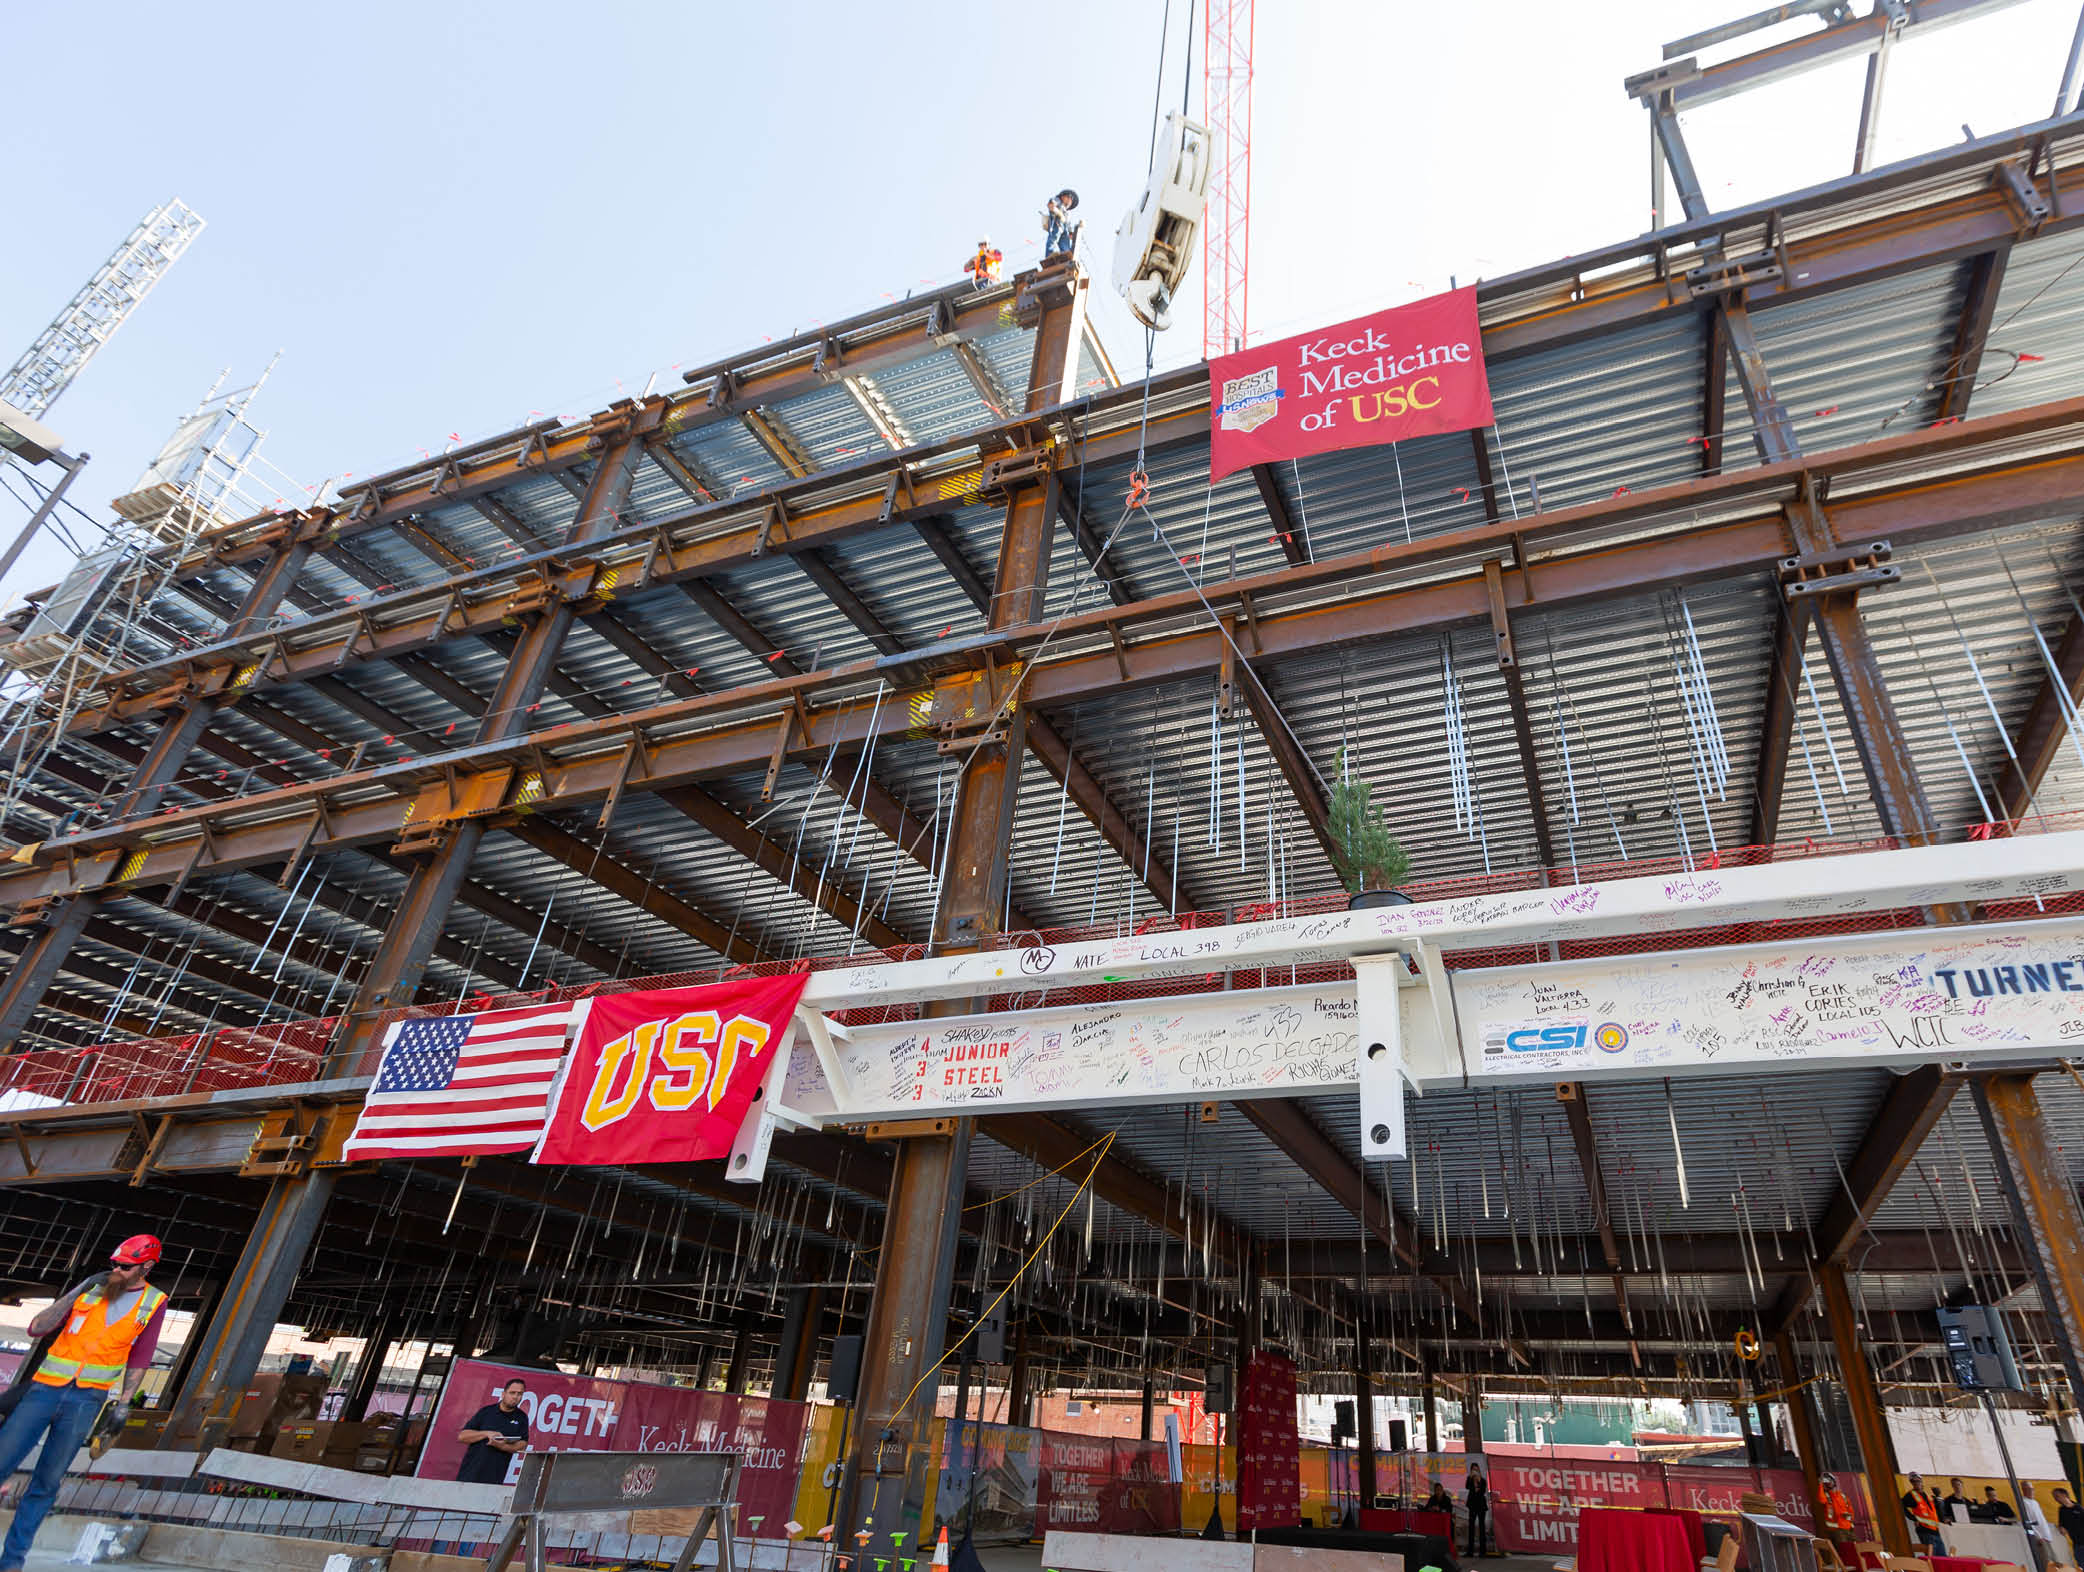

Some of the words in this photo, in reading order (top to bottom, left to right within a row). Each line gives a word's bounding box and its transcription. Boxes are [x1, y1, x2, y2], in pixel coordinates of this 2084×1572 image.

[1298, 327, 1391, 368] Keck
[1298, 342, 1472, 398] Medicine
[1225, 370, 1274, 396] BEST
[1226, 382, 1274, 404] HOSPITALS
[1299, 398, 1343, 432] of
[1348, 376, 1442, 423] USC
[1073, 953, 1110, 970] NATE
[1140, 946, 1189, 961] LOCAL
[1194, 941, 1221, 954] 398
[1808, 983, 1850, 997] ERIK
[1935, 961, 2084, 999] TURNE
[1314, 998, 1351, 1012] Ricardo
[1563, 998, 1591, 1013] 433
[1818, 1009, 1857, 1022] LOCAL
[1859, 1006, 1881, 1017] 105
[1071, 1012, 1122, 1035] ALEJANDRO
[921, 1035, 930, 1053] 4
[1506, 1025, 1588, 1053] CSI
[943, 1042, 1010, 1063] JUNIOR
[1178, 1043, 1269, 1075] CARLOS
[1485, 1053, 1522, 1062] ELECTRICAL
[916, 1060, 927, 1077] 3
[943, 1066, 1004, 1086] STEEL
[912, 1084, 923, 1101] 3
[638, 1425, 693, 1453] Keck
[1053, 1443, 1105, 1469] TOGETHER
[1051, 1471, 1067, 1493] WE
[1068, 1472, 1089, 1494] ARE
[1513, 1466, 1641, 1494] TOGETHER
[1049, 1499, 1100, 1523] LIMITLESS
[1515, 1493, 1553, 1514] WE
[1688, 1488, 1745, 1512] Keck
